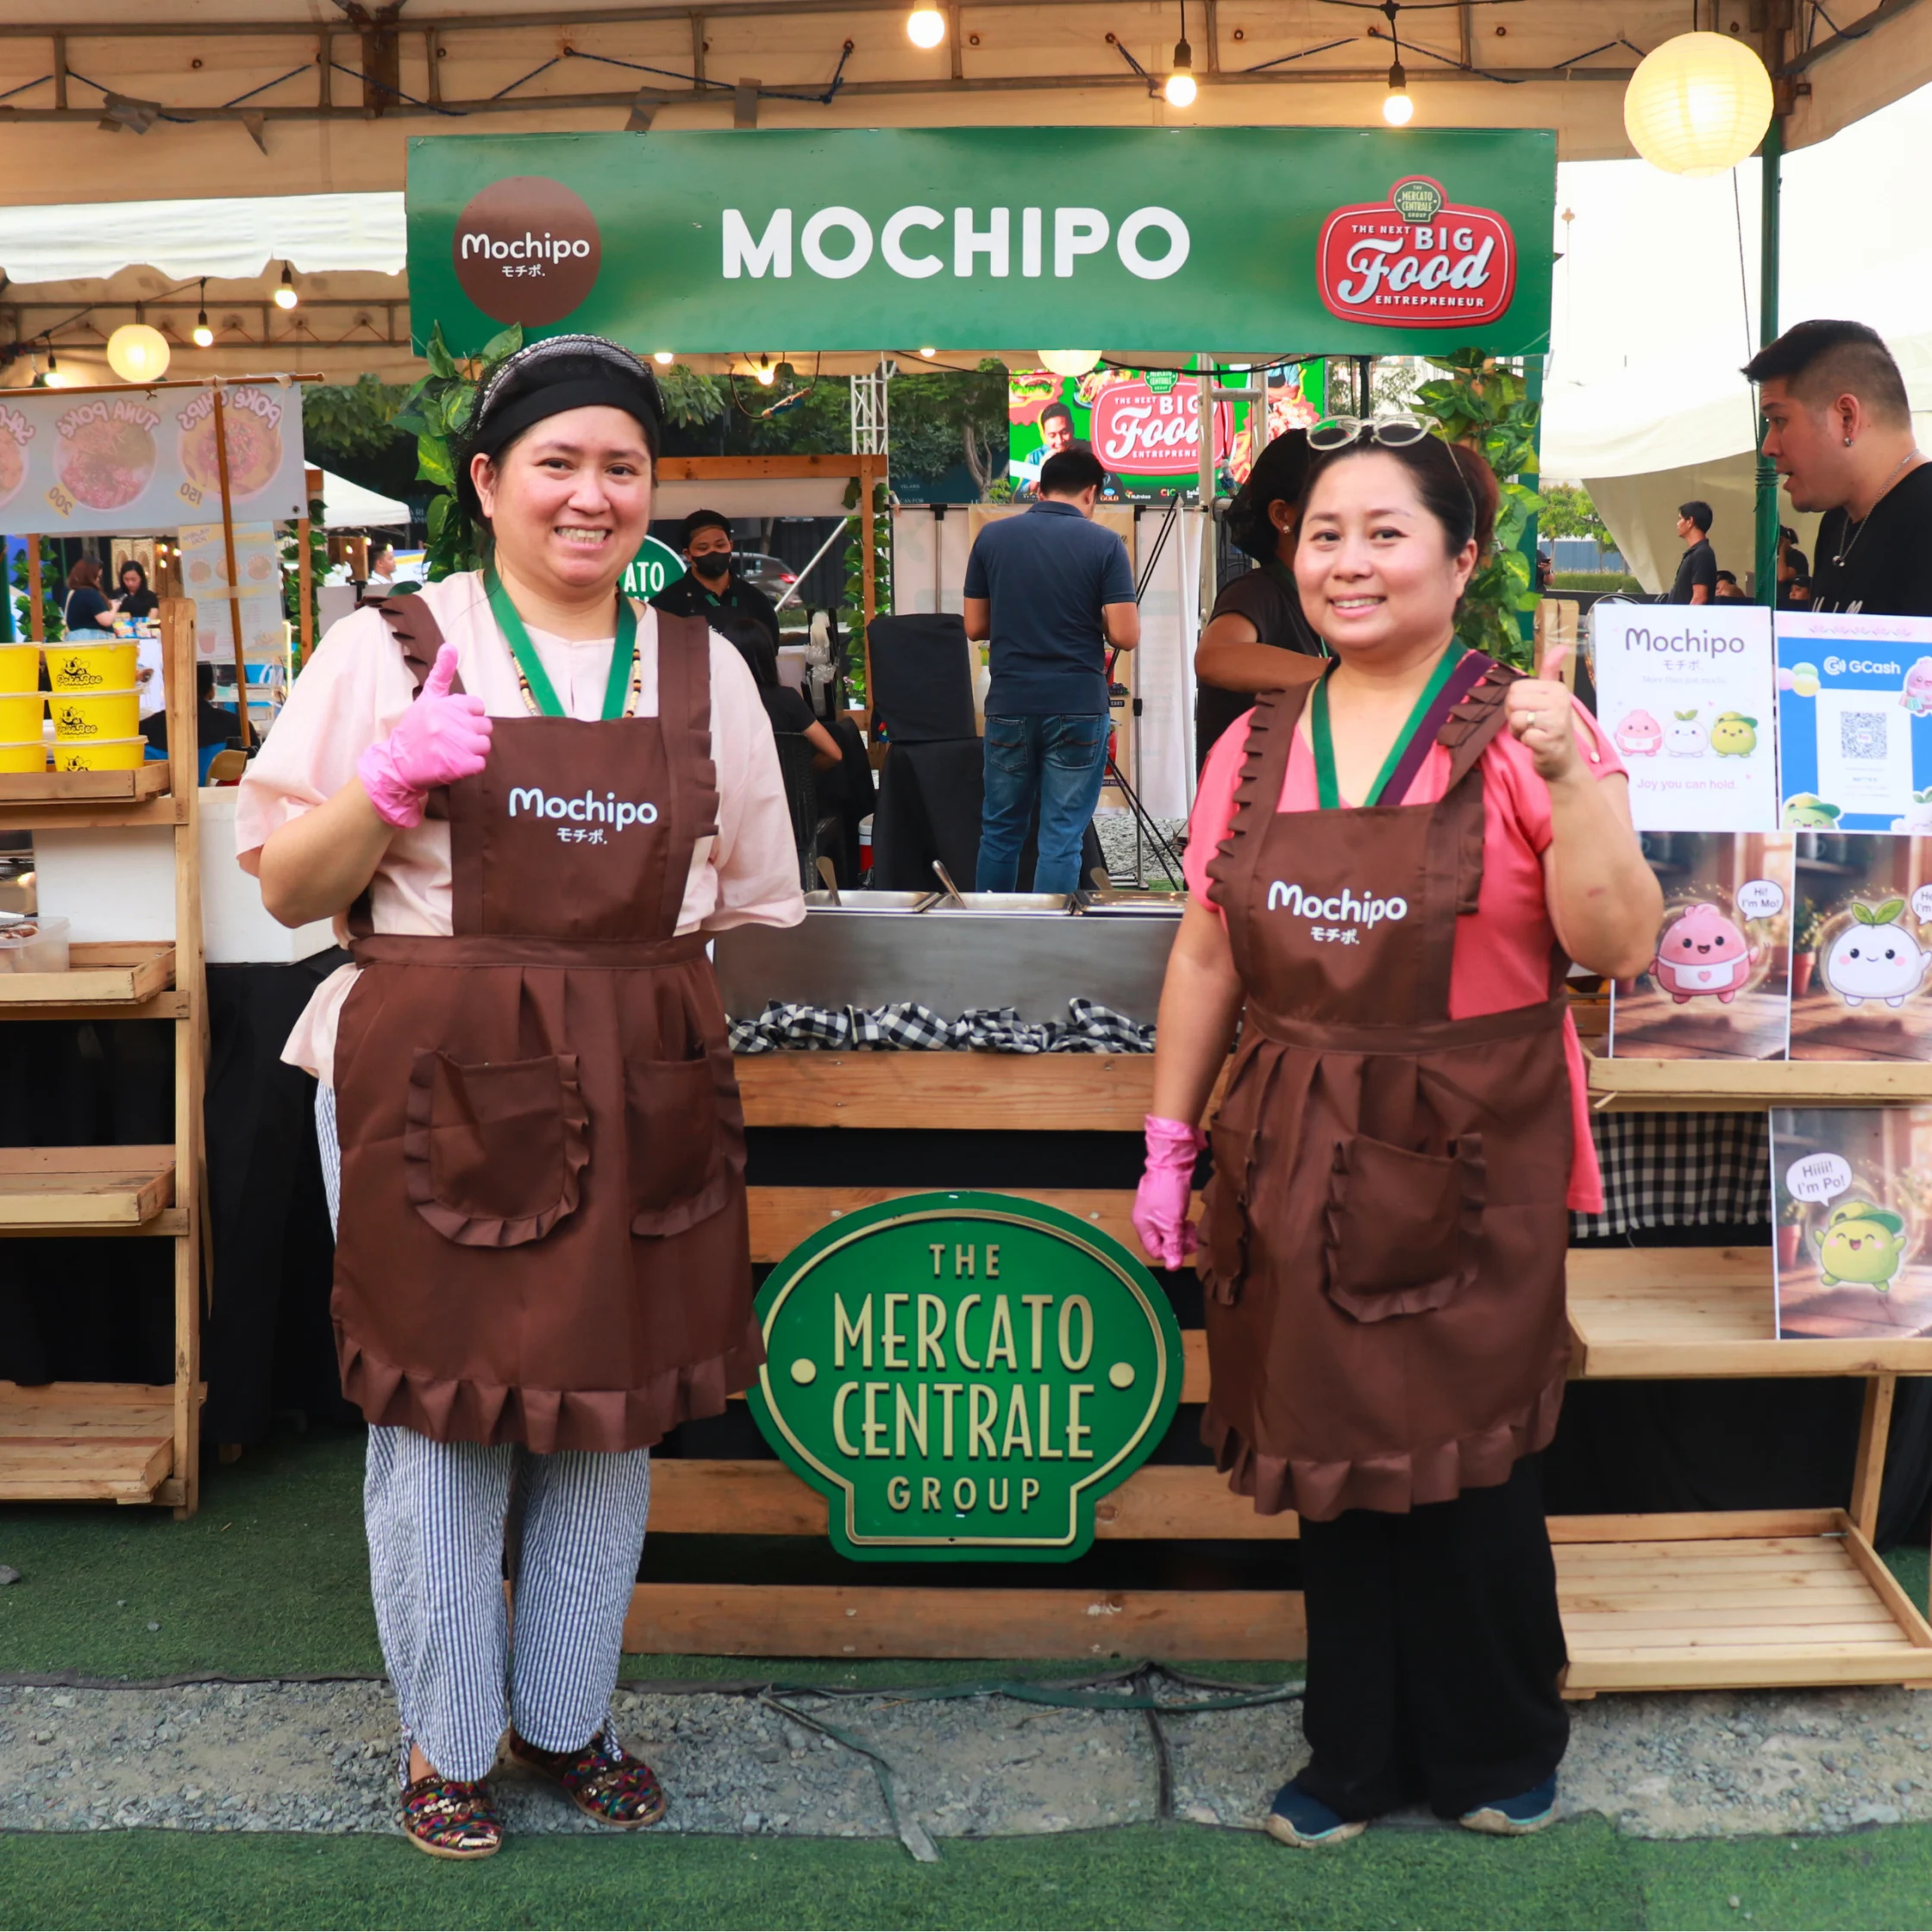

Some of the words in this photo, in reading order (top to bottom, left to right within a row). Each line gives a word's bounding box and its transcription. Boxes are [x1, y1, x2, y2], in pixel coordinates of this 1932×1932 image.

[1402, 191, 1433, 201] MERCATO
[1402, 201, 1433, 211] CENTRALE
[461, 231, 590, 265] Mochipo
[722, 205, 1190, 279] MOCHIPO
[1352, 224, 1375, 234] THE
[1380, 225, 1411, 235] NEXT
[1414, 226, 1474, 251] BIG
[1337, 235, 1495, 304] Food
[1375, 295, 1484, 307] ENTREPRENEUR
[1132, 449, 1197, 458] ENTREPRENE
[624, 561, 665, 593] ATO
[1625, 627, 1746, 659] Mochipo
[1848, 660, 1901, 675] GCash
[1637, 778, 1658, 791] Joy
[1661, 781, 1682, 791] you
[509, 787, 658, 832] Mochipo
[1267, 880, 1408, 930] Mochipo
[1754, 888, 1768, 896] Hi!
[1797, 1182, 1820, 1195] I'm
[1823, 1174, 1846, 1190] Po!
[929, 1244, 1000, 1277] THE
[833, 1293, 1095, 1371] MERCATO
[833, 1382, 1095, 1460] CENTRALE
[887, 1476, 1040, 1512] GROUP
